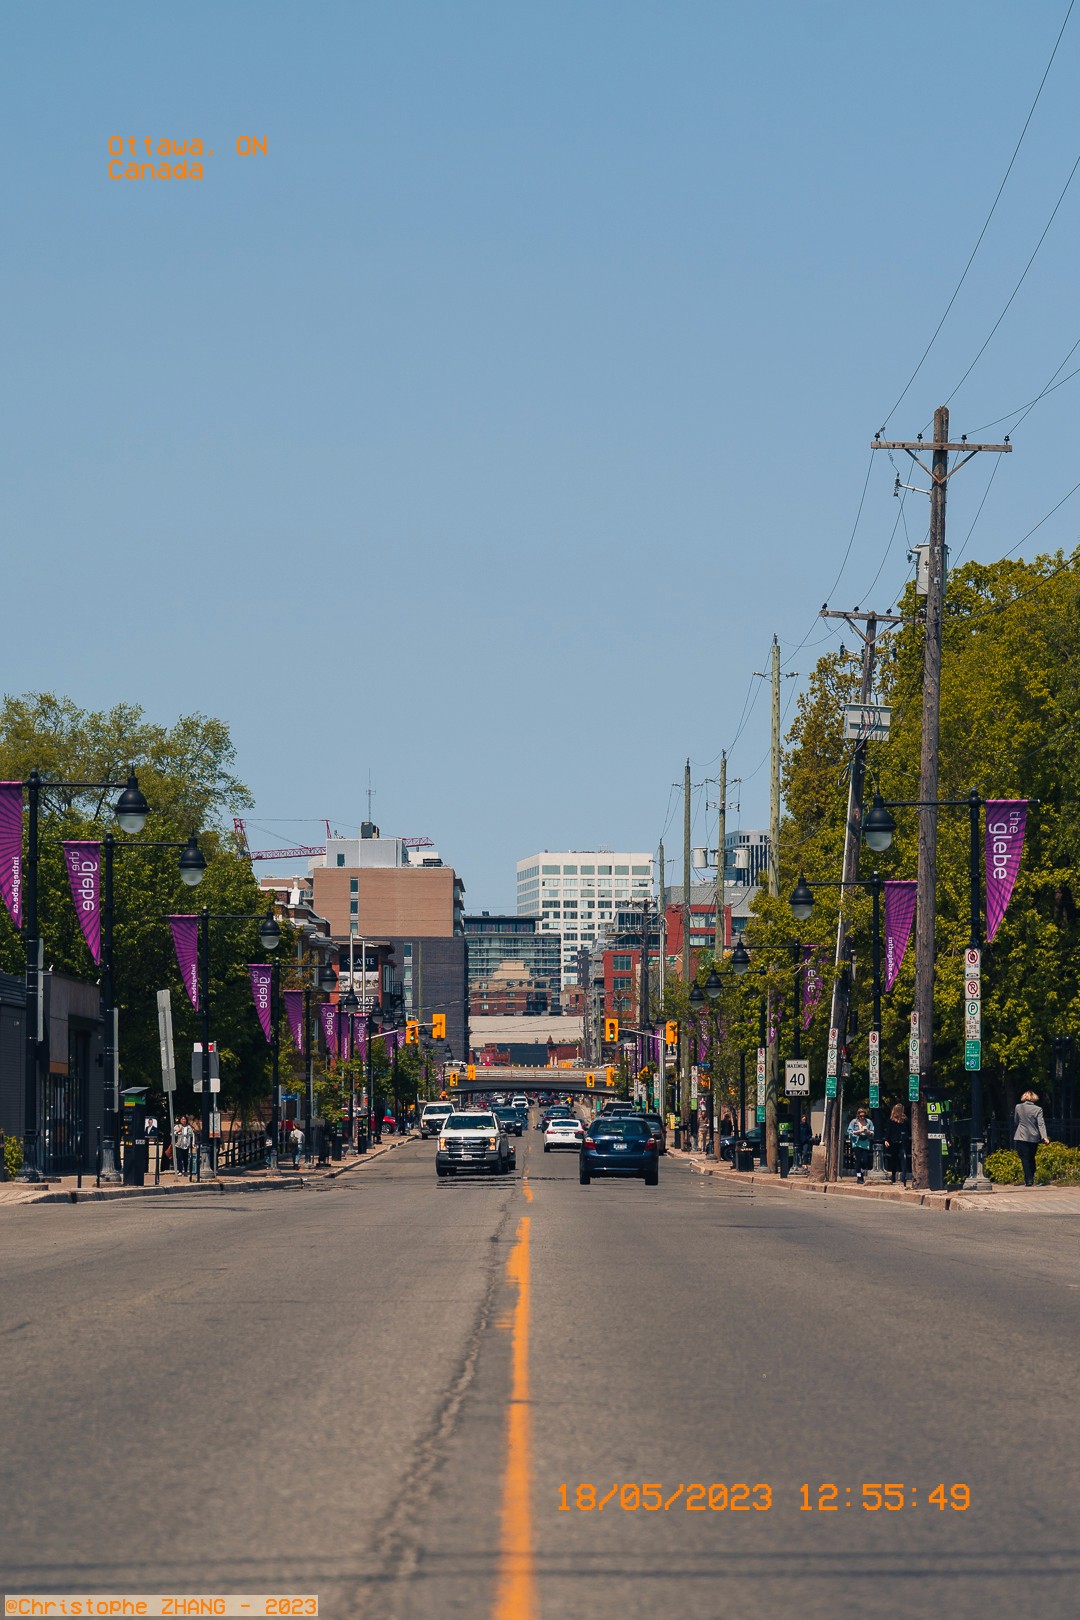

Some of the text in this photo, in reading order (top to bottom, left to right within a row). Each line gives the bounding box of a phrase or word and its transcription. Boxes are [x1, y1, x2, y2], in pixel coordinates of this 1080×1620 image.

[1009, 811, 1022, 834] the
[988, 822, 1013, 880] glebe
[789, 1072, 806, 1086] 40
